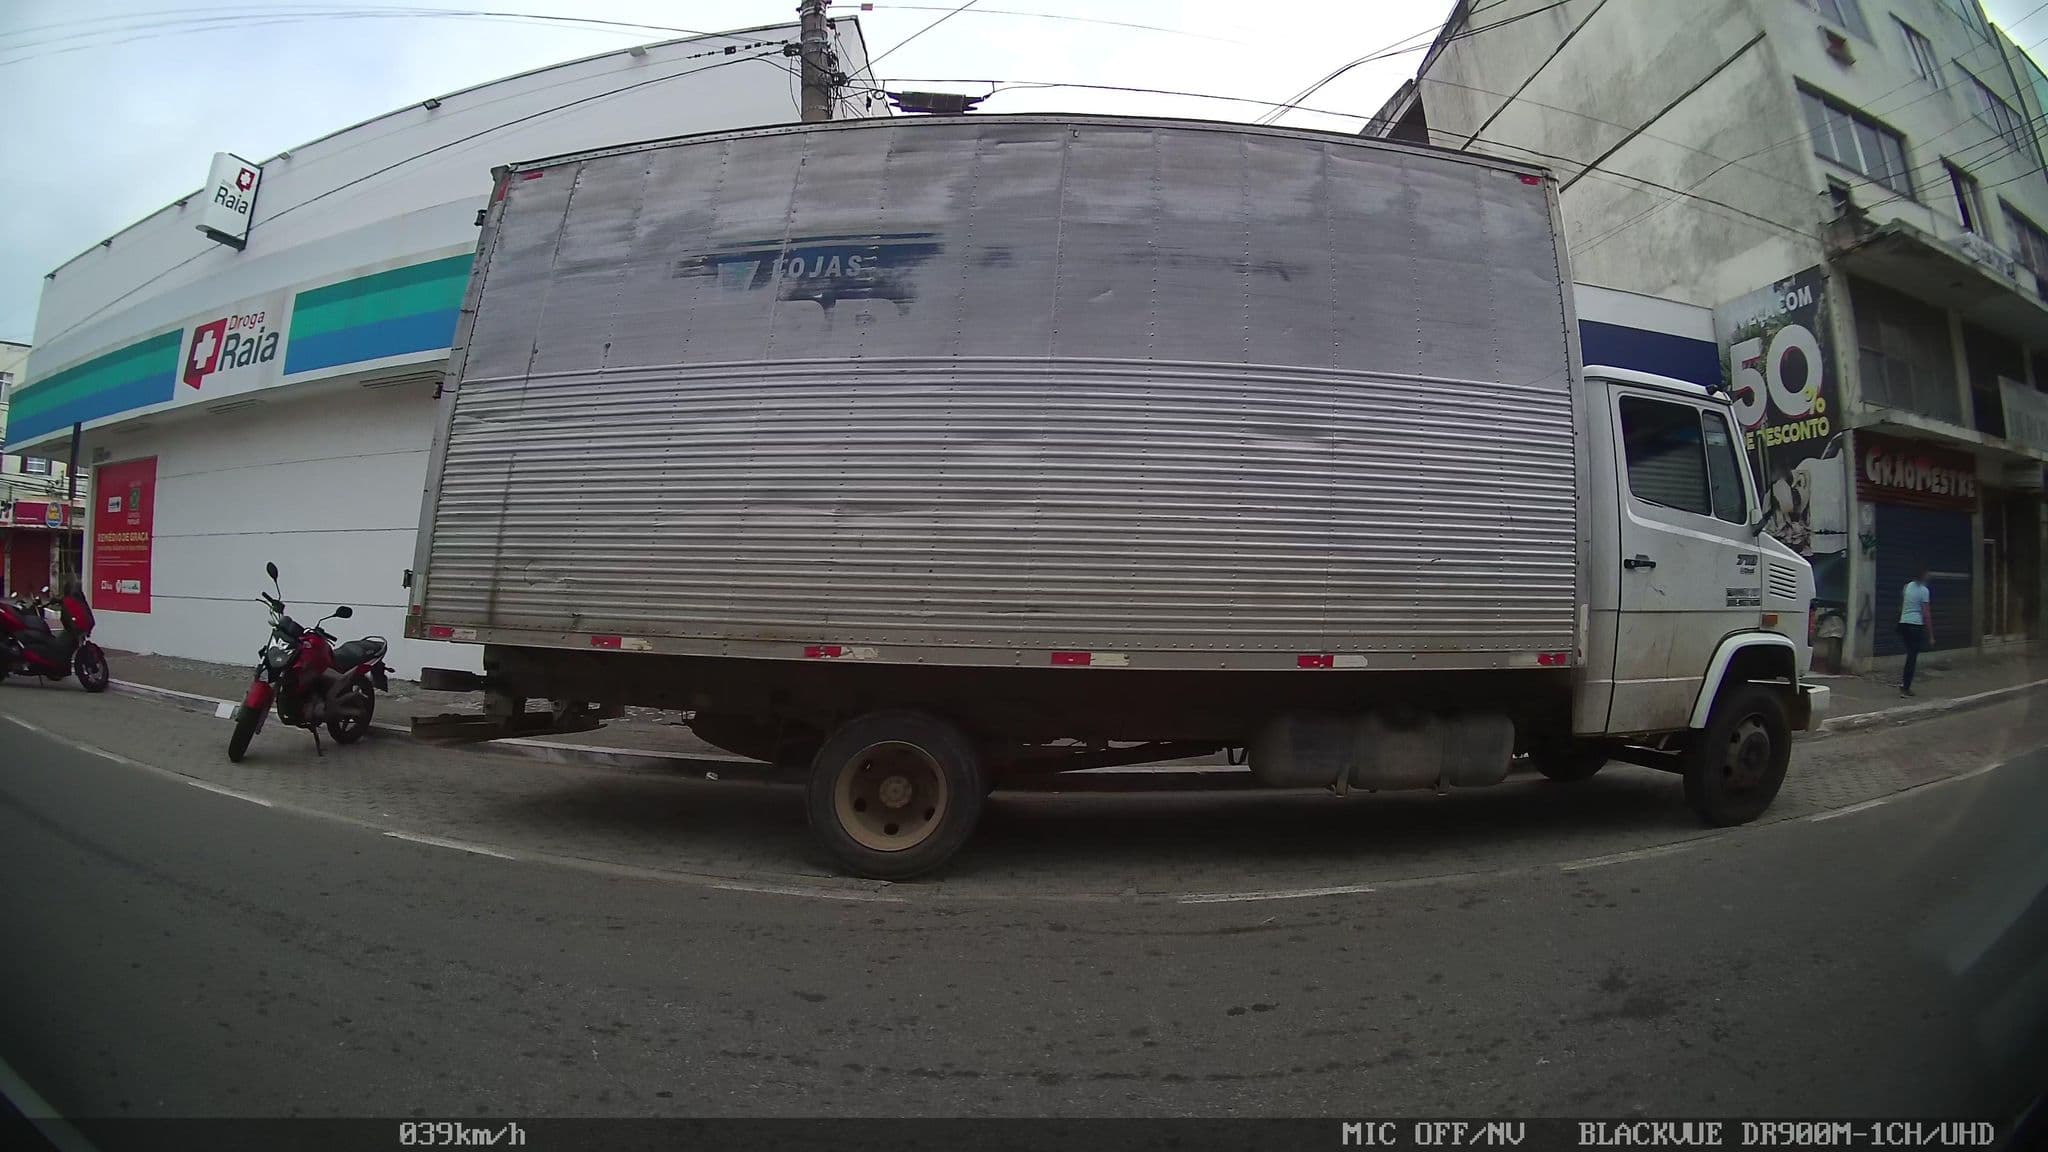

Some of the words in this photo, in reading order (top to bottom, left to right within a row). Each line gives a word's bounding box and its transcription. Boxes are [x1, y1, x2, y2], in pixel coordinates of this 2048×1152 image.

[214, 186, 248, 214] Raia
[228, 311, 265, 330] Droga
[219, 327, 279, 371] Raia
[1730, 324, 1826, 427] 50%
[1744, 431, 1755, 450] E
